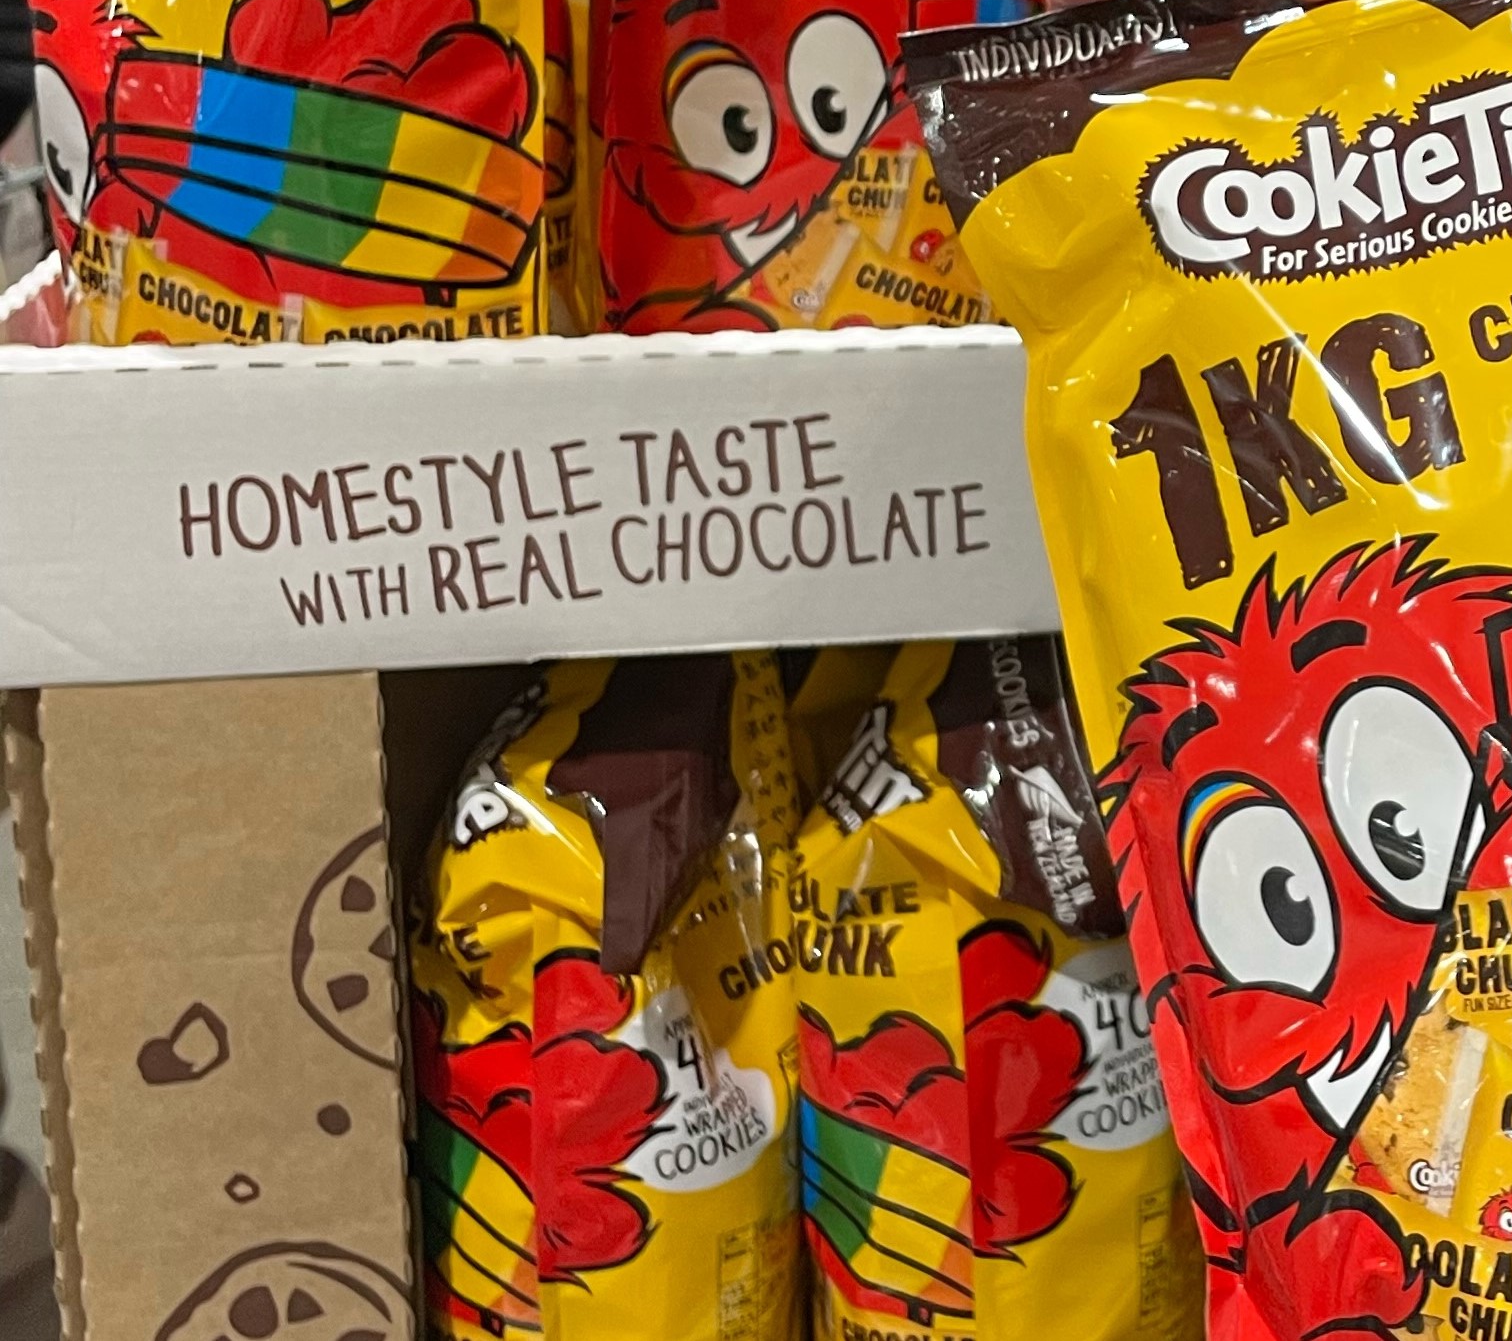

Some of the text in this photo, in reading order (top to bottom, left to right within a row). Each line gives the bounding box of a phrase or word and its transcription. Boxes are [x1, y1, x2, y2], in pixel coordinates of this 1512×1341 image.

[1262, 244, 1307, 276] For
[1313, 227, 1415, 268] Serious
[1420, 202, 1512, 244] Cookie
[180, 412, 844, 558] HOMESTYLE TASTE
[1109, 312, 1467, 592] 1KG
[280, 483, 991, 627] WITH REAL CHOCOLATE
